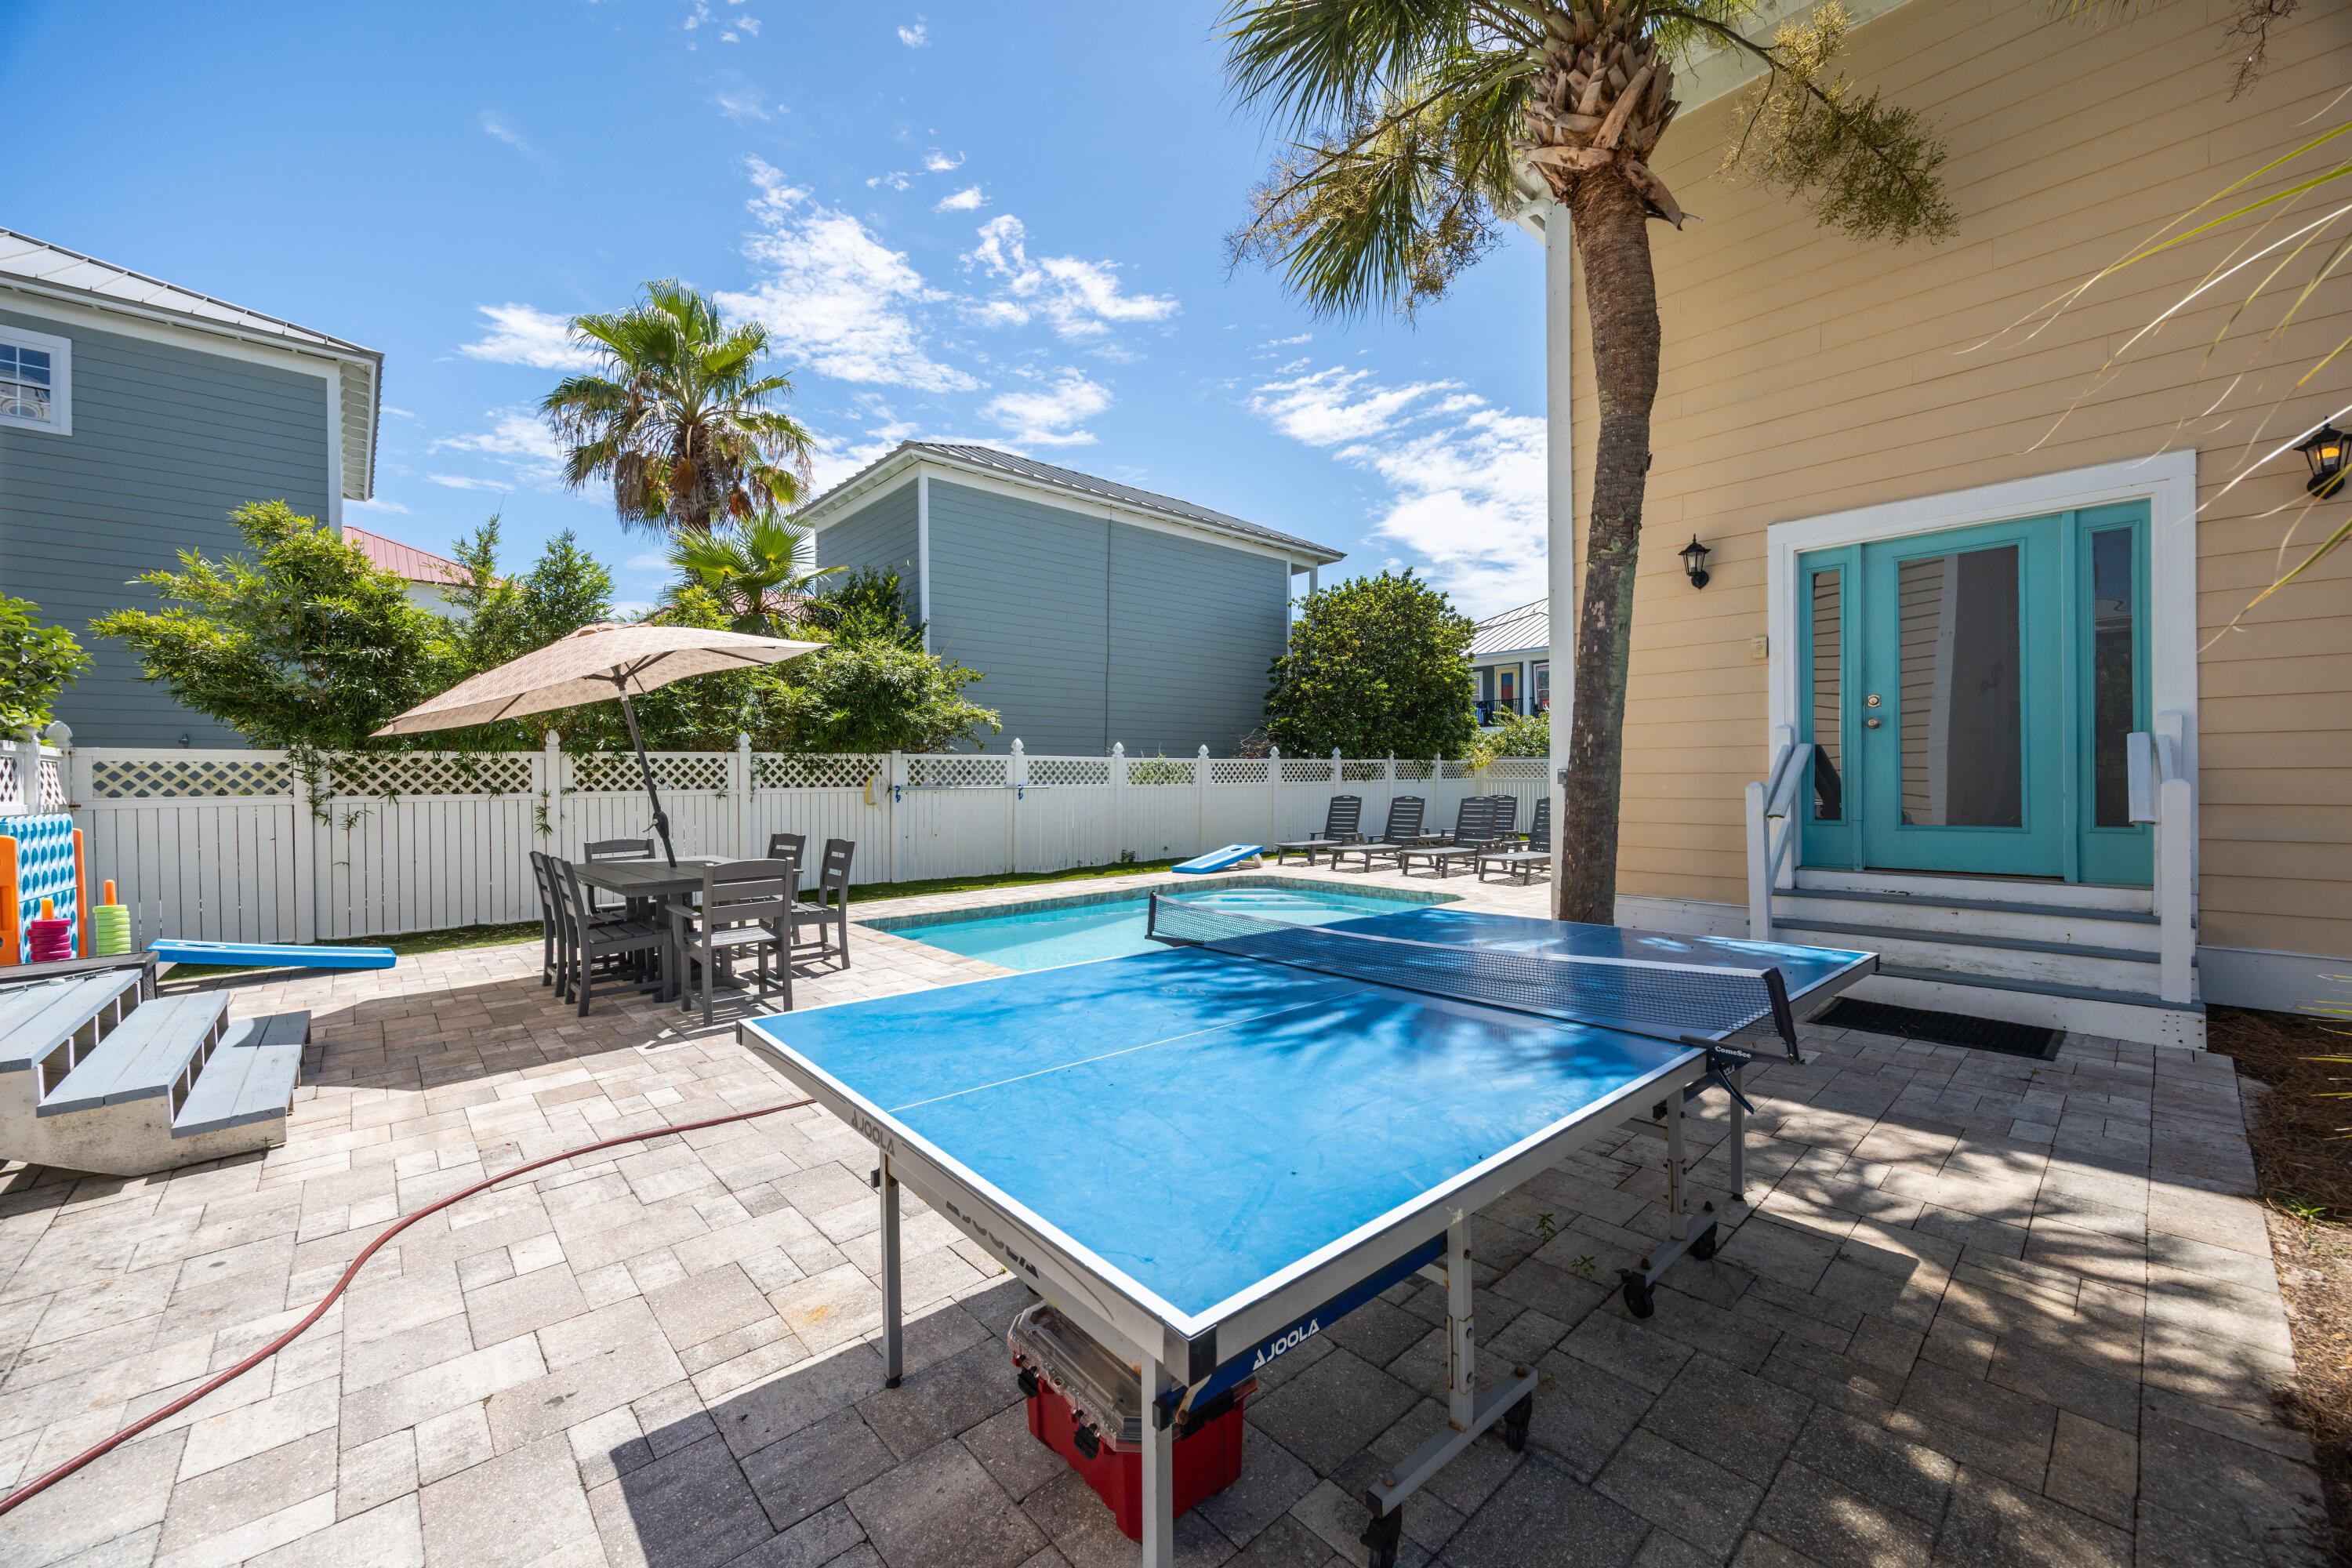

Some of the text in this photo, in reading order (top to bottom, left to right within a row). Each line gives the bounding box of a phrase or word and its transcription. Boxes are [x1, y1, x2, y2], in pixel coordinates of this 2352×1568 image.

[1715, 1046, 1751, 1058] ComeSee
[859, 1117, 896, 1156] JOOLA
[1266, 1318, 1320, 1363] JOOLA
